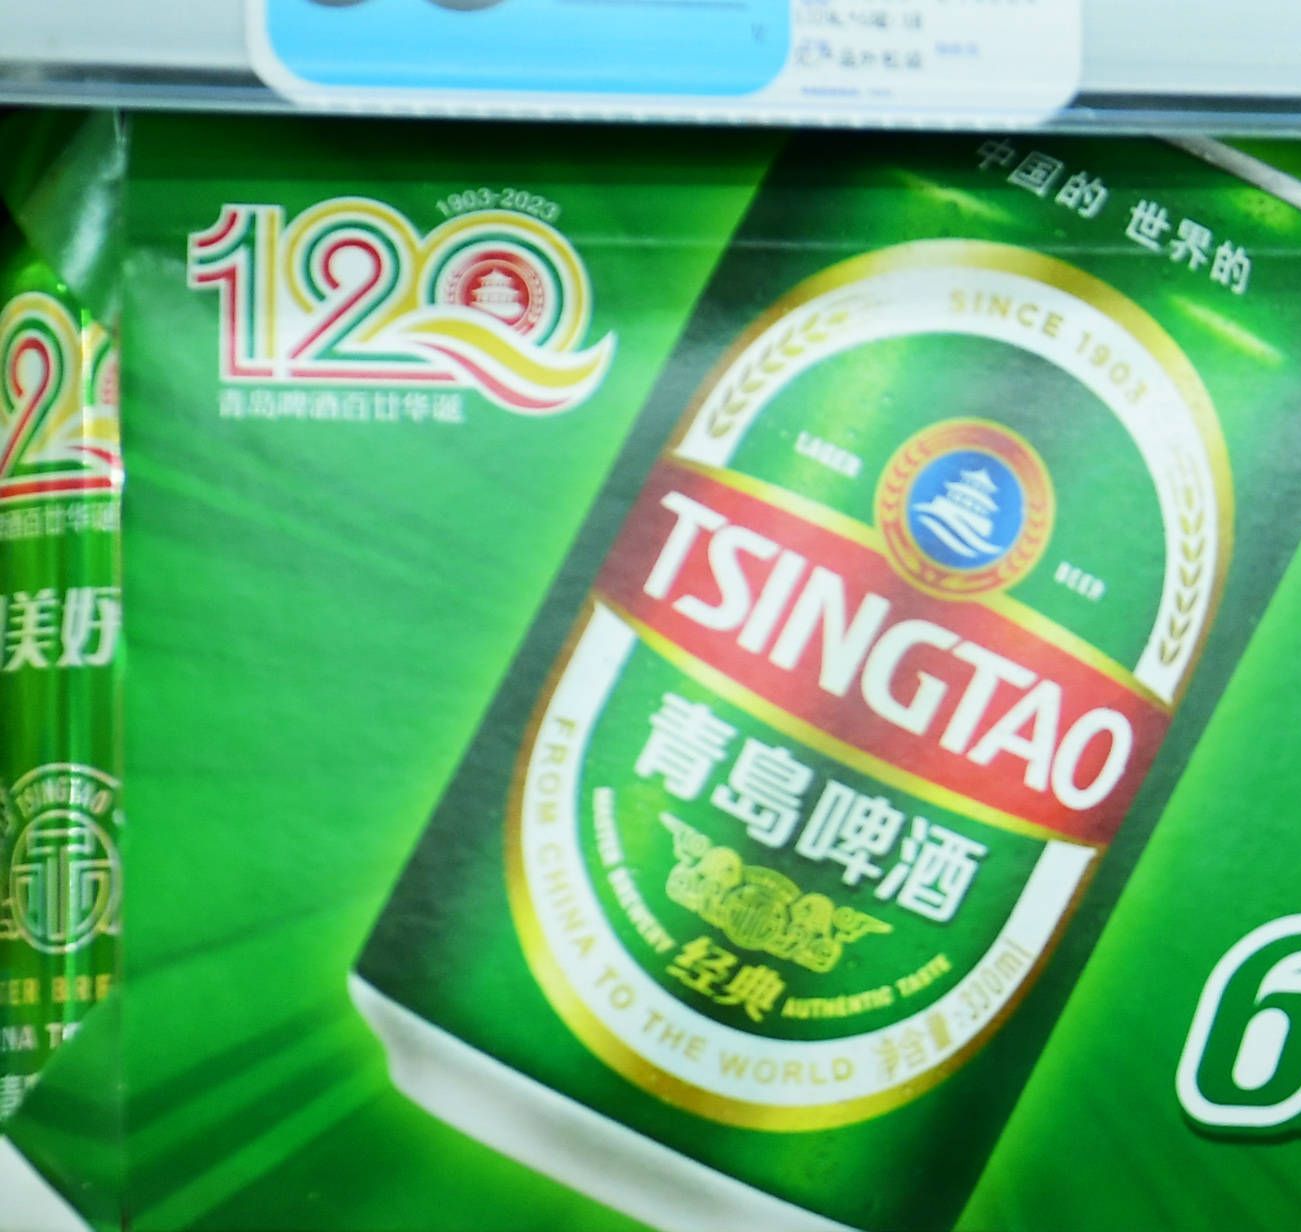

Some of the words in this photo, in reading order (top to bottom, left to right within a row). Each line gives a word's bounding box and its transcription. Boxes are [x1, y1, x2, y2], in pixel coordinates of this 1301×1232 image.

[437, 187, 561, 221] 1903-2023
[976, 138, 1109, 219] 中国的
[1125, 199, 1251, 295] 世界的
[949, 288, 1062, 338] SINCE
[1077, 331, 1150, 404] 1903
[794, 430, 863, 479] LAGER
[1054, 561, 1107, 601] BEER
[0, 587, 120, 672] 美好
[643, 489, 1135, 810] TSINGTAO
[537, 716, 577, 824] FROM
[632, 691, 989, 924] 青島啤酒
[537, 842, 597, 960] CHINA
[596, 965, 638, 1012] TO
[666, 936, 785, 1022] 经典
[641, 1011, 707, 1060] THE
[719, 1051, 856, 1086] WORLD
